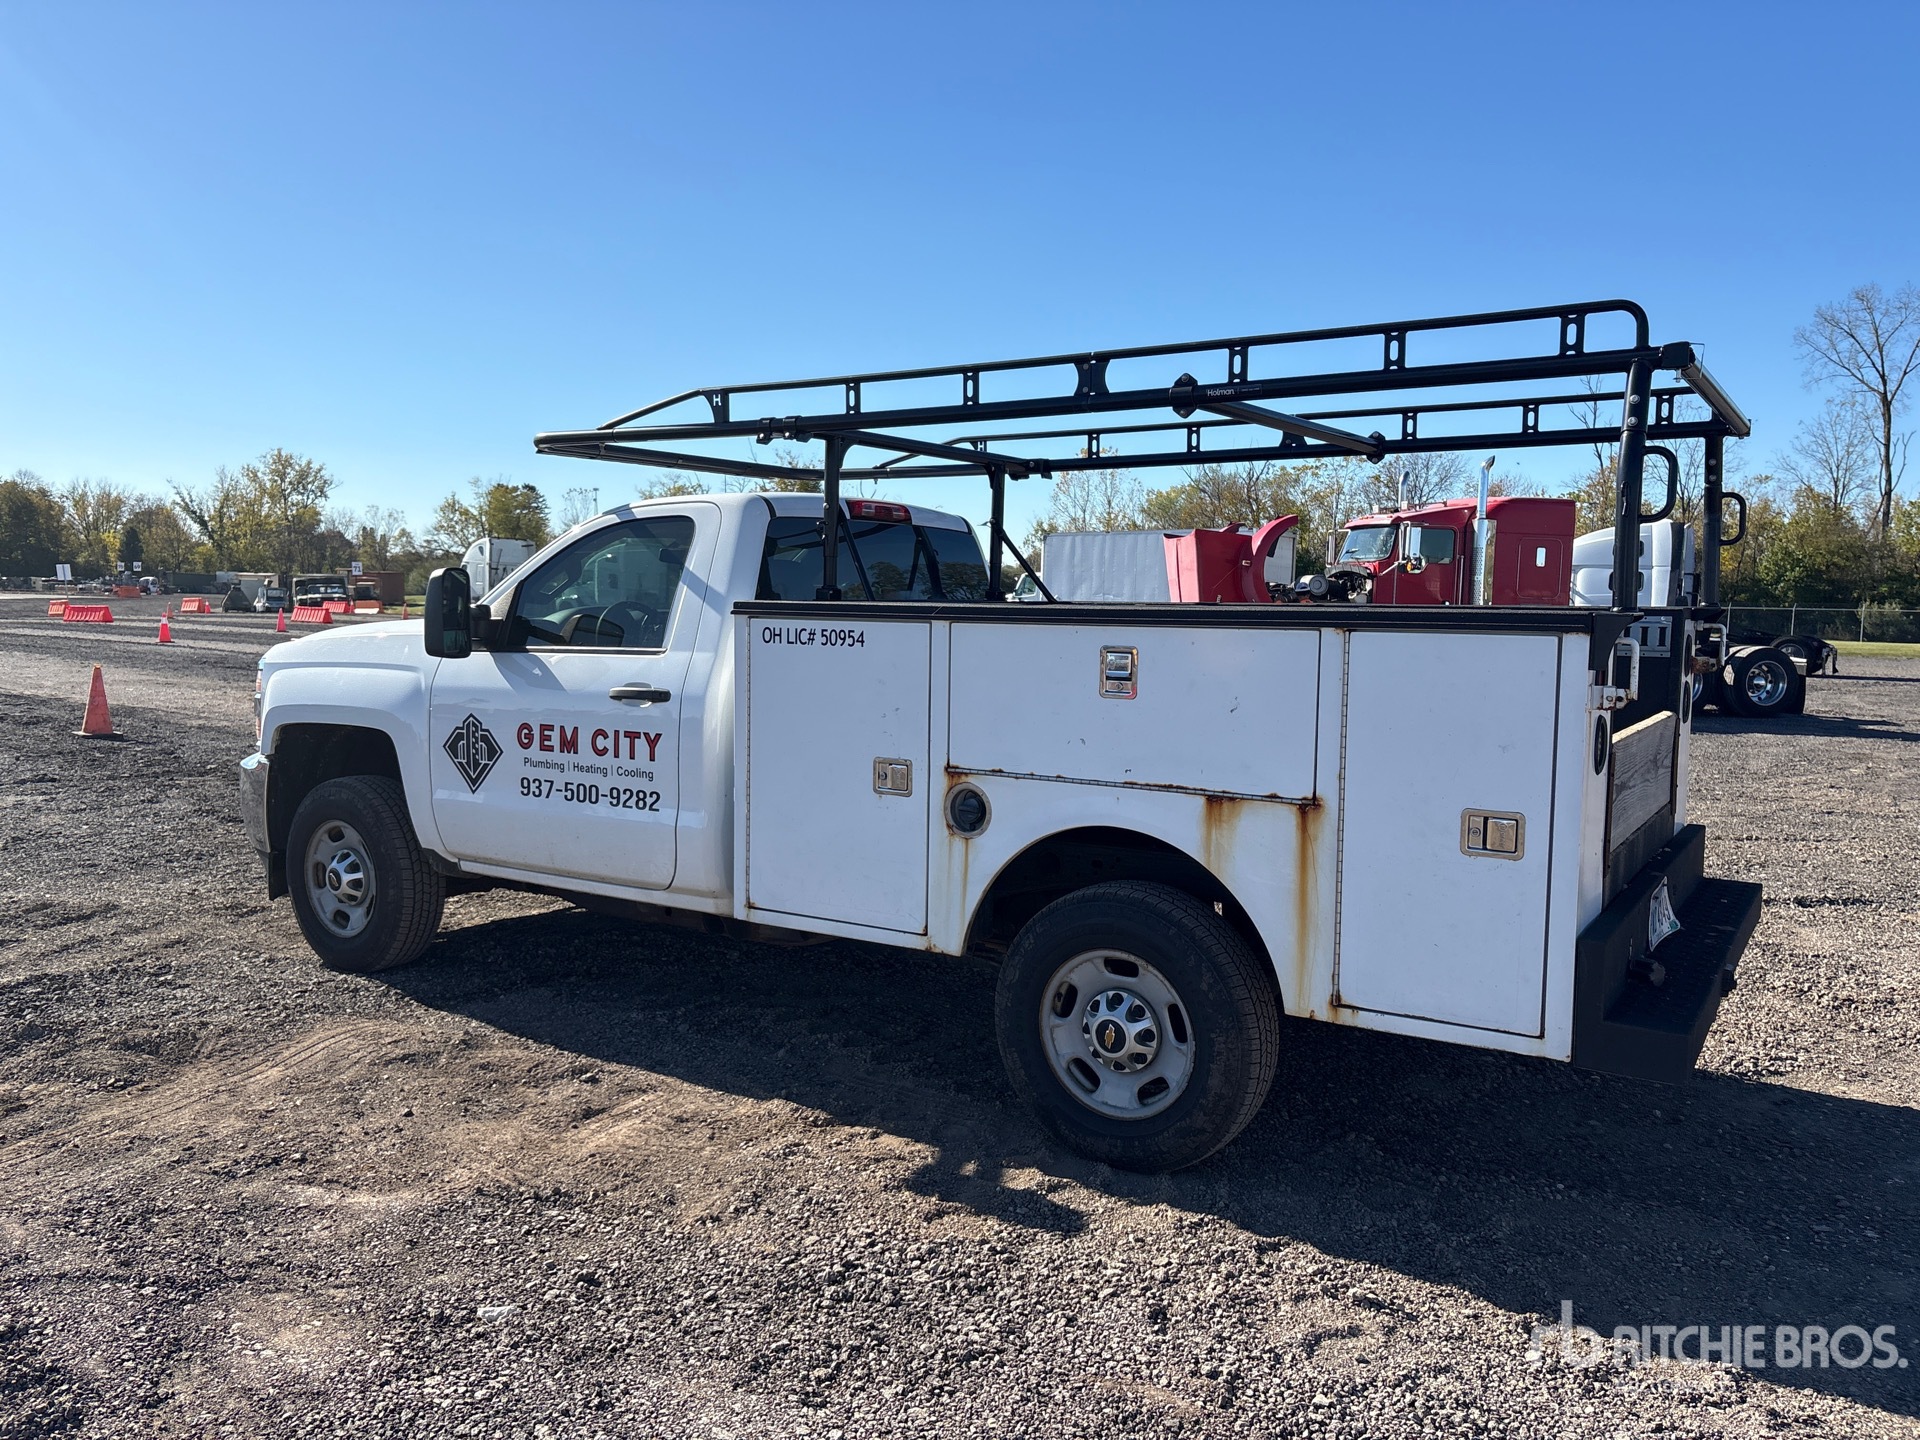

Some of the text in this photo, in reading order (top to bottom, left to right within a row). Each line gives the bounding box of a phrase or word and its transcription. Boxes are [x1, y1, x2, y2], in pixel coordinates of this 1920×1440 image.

[1207, 388, 1235, 397] Holman
[762, 626, 865, 648] OH LIC# 50954
[516, 722, 663, 762] GEM CITY
[523, 757, 654, 782] Plumbing Heating Cooling
[520, 776, 661, 812] 937-500-9282
